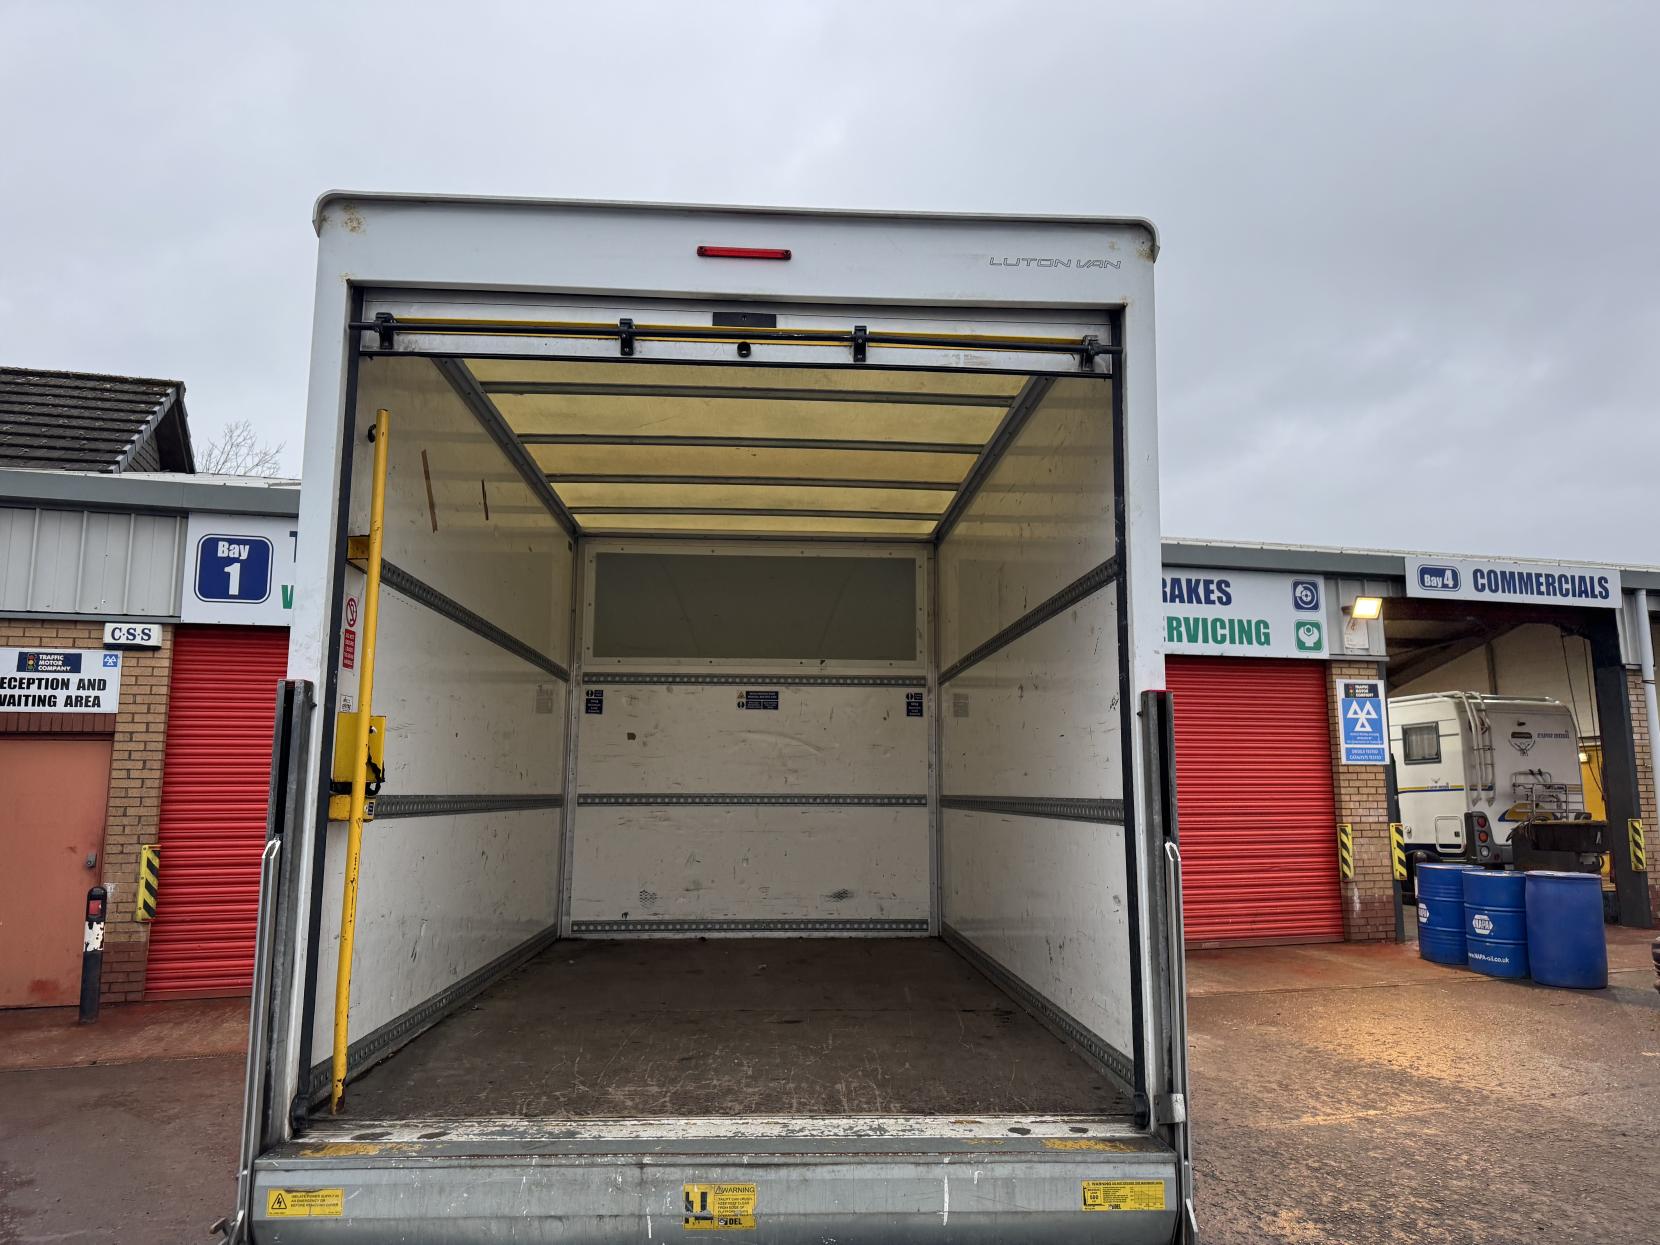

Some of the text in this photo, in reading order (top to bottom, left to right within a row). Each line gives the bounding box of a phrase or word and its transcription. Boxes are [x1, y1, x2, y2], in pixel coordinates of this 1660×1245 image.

[990, 257, 1121, 269] LUTON VAN
[217, 541, 250, 559] Bay
[224, 562, 240, 595] 1
[1424, 568, 1610, 600] Bay 4 COMMERCIALS
[1163, 616, 1271, 646] RVICING
[76, 678, 107, 691] AND
[64, 694, 101, 708] AREA
